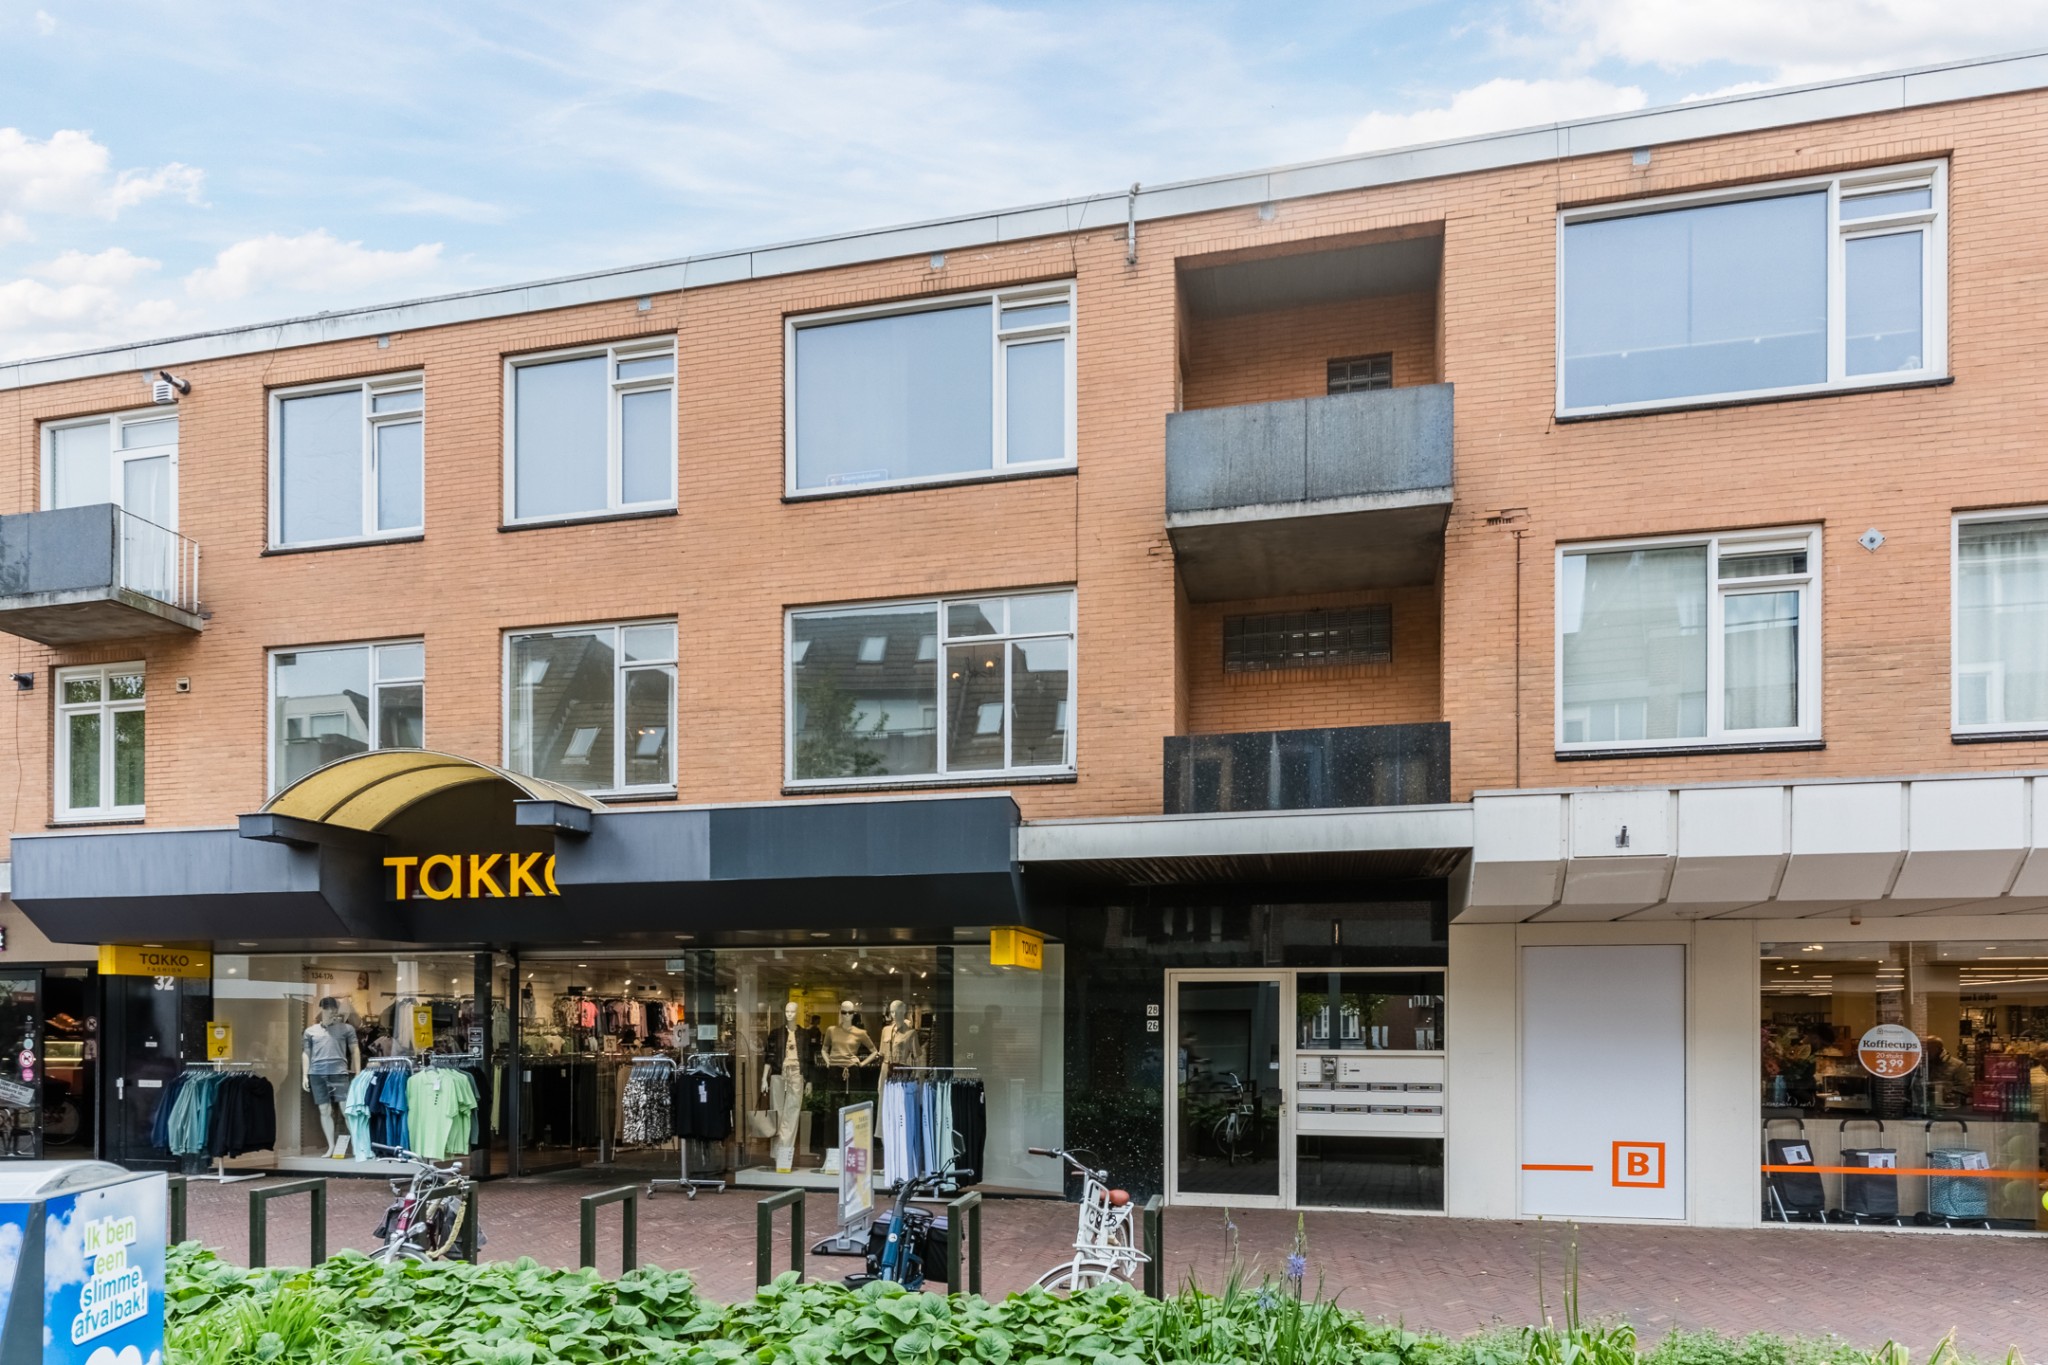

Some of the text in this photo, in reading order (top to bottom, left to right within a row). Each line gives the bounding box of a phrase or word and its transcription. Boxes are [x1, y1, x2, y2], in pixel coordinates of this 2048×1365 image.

[154, 976, 175, 990] 32
[1148, 1005, 1158, 1015] 28
[1148, 1021, 1158, 1031] 26
[1863, 1040, 1918, 1050] Koffiecups
[1628, 1152, 1649, 1176] B
[87, 1221, 133, 1250] Ik ben
[96, 1250, 124, 1274] een
[83, 1271, 139, 1307] slimme
[75, 1287, 145, 1338] afvalbak!
